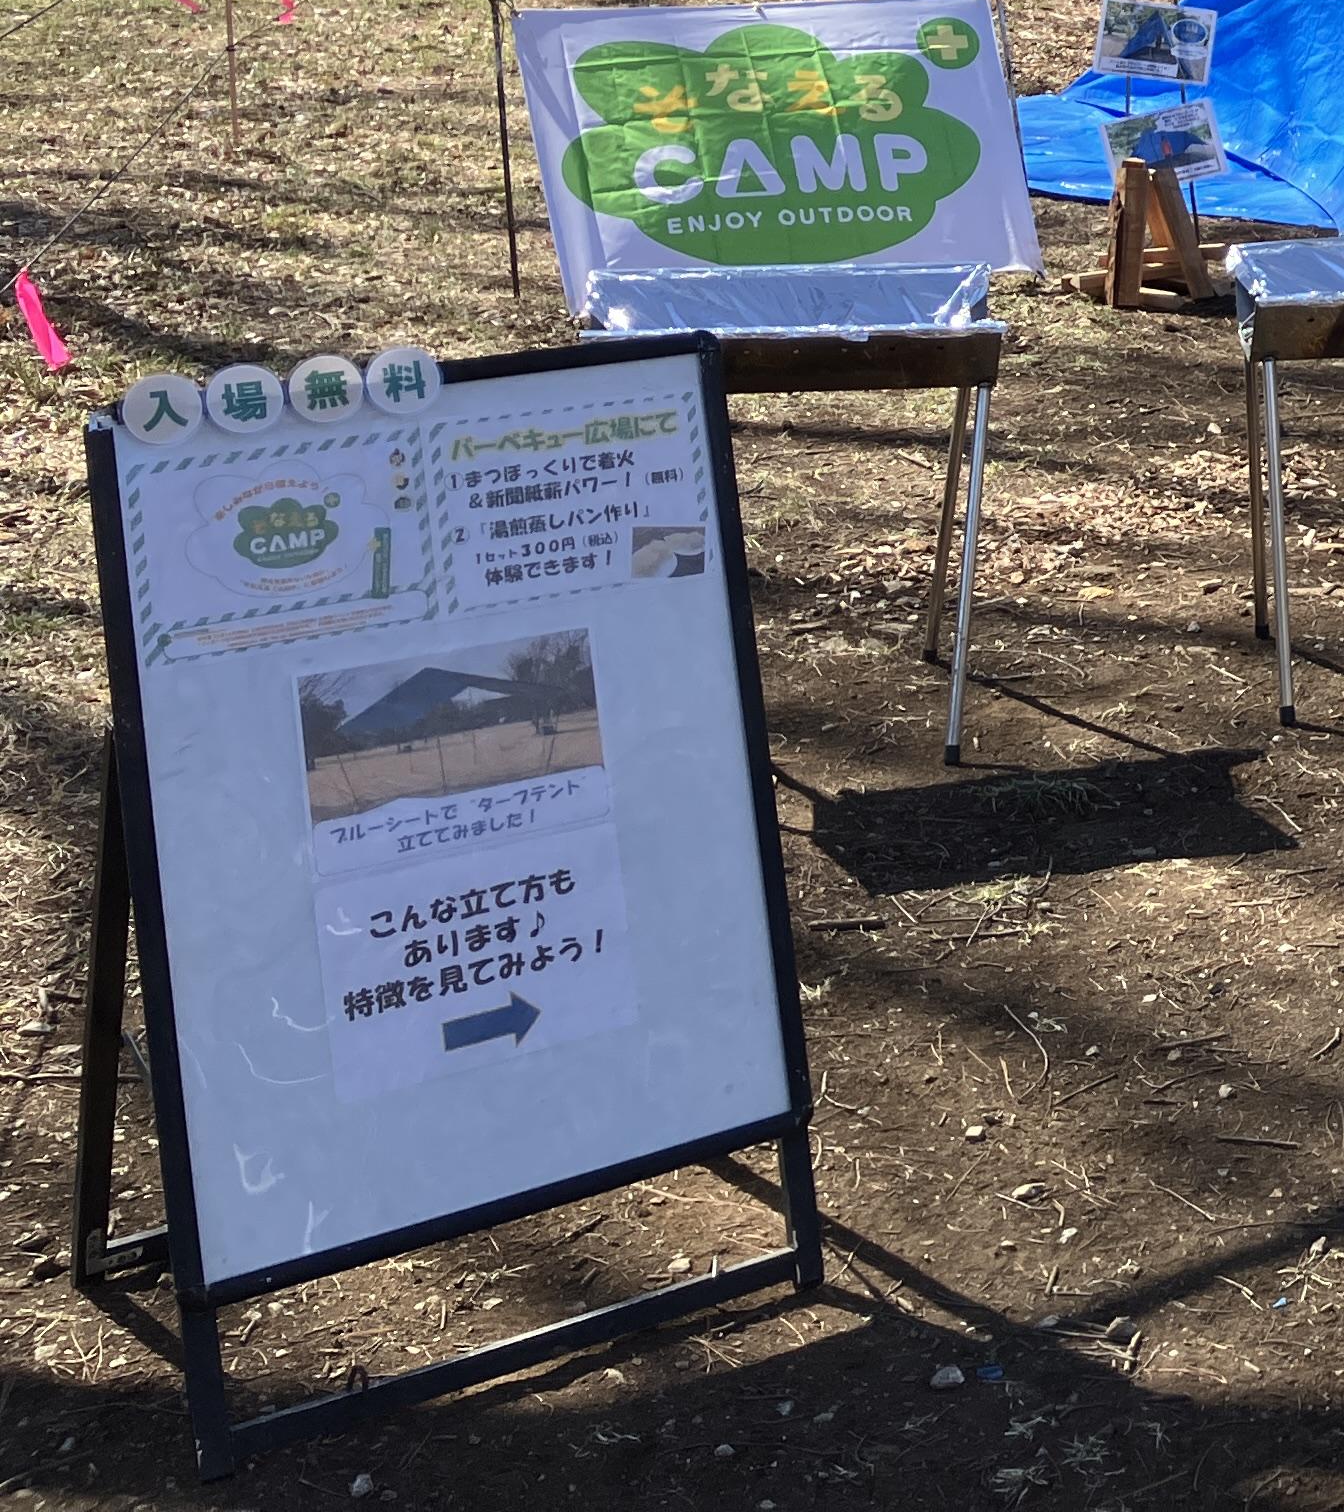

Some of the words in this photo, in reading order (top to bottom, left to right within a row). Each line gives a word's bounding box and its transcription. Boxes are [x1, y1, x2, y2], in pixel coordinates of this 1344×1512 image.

[633, 62, 904, 134] そなえる
[633, 132, 929, 205] CAMP
[666, 209, 764, 236] ENJOY
[777, 204, 914, 227] OUTDOOR
[141, 359, 428, 434] 入場無料
[451, 410, 678, 461] バーベキュー広場にて
[249, 528, 326, 555] CAMP
[369, 868, 577, 939] こんな立て方も
[342, 928, 604, 1022] 特徴を見てみよう!
